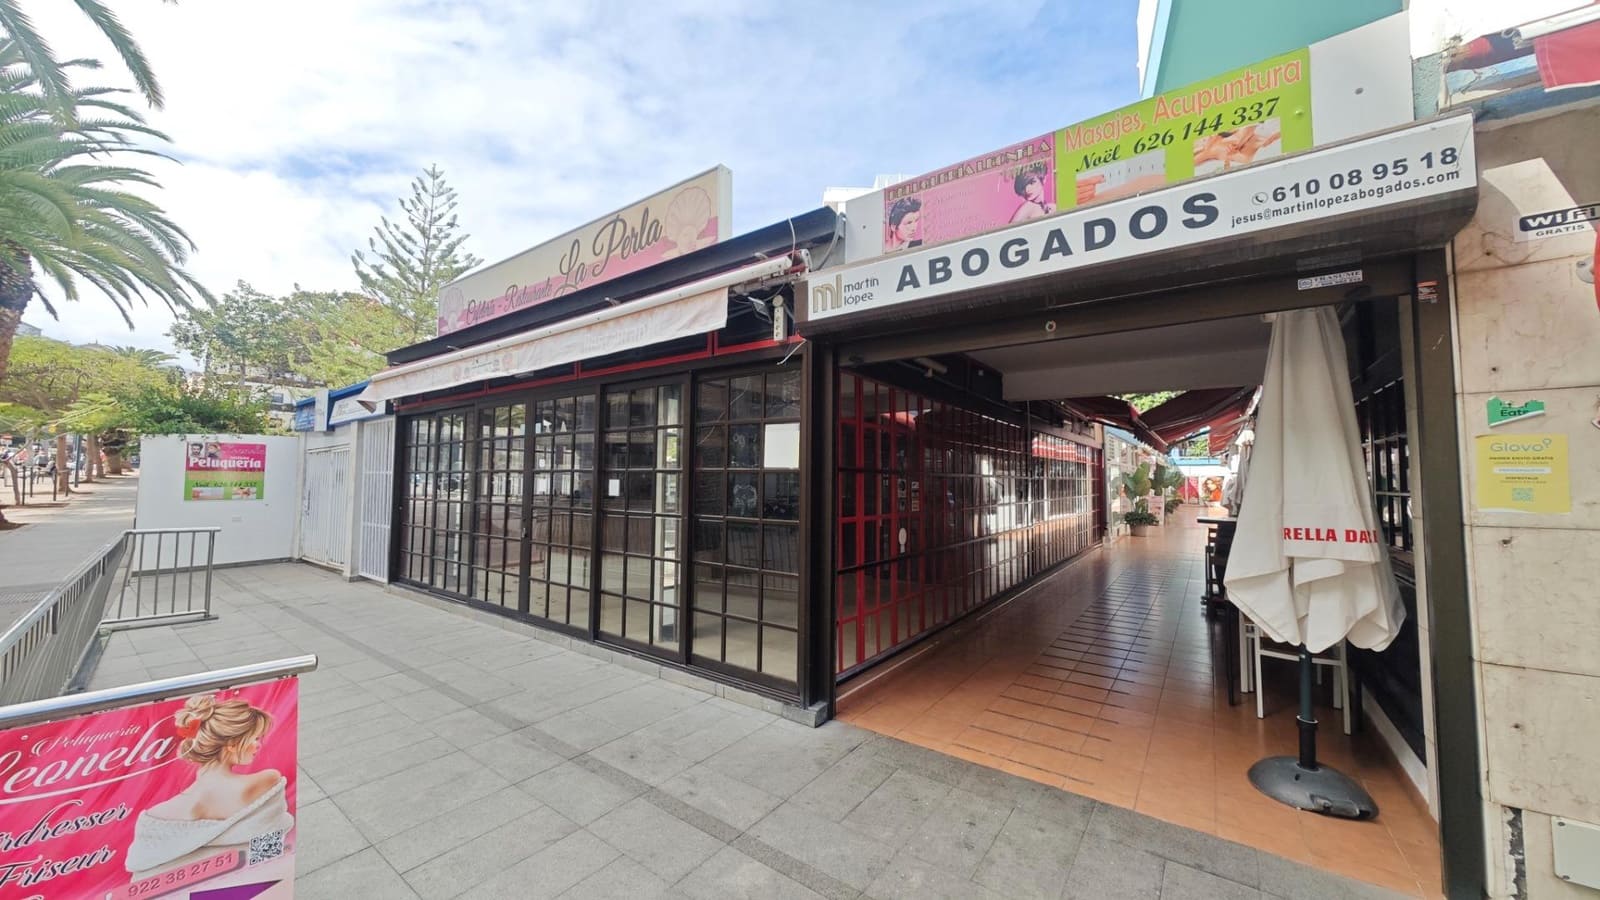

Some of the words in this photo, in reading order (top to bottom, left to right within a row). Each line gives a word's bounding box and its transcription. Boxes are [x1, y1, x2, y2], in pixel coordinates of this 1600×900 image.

[1065, 111, 1146, 153] Masajes,
[1153, 59, 1302, 125] Acupuntura
[1076, 144, 1121, 172] Noël
[1133, 131, 1174, 155] 626
[1182, 113, 1223, 140] 144
[1231, 96, 1280, 126] 337
[1231, 170, 1460, 228] jesus@martinlopezabogados.com
[1272, 179, 1321, 202] 610
[1329, 169, 1363, 190] 08
[1372, 158, 1408, 180] 95
[1420, 147, 1458, 169] 18
[554, 238, 588, 298] La
[592, 207, 664, 277] Perla
[895, 192, 1220, 293] ABOGADOS
[1536, 224, 1585, 237] GRATIS
[189, 456, 262, 469] Peluquería
[1489, 442, 1543, 453] Glovo
[0, 800, 131, 850] rdresser
[0, 845, 115, 888] Friseur
[127, 878, 161, 898] 922
[165, 869, 186, 885] 38
[191, 861, 210, 876] 27
[215, 852, 233, 868] 51
